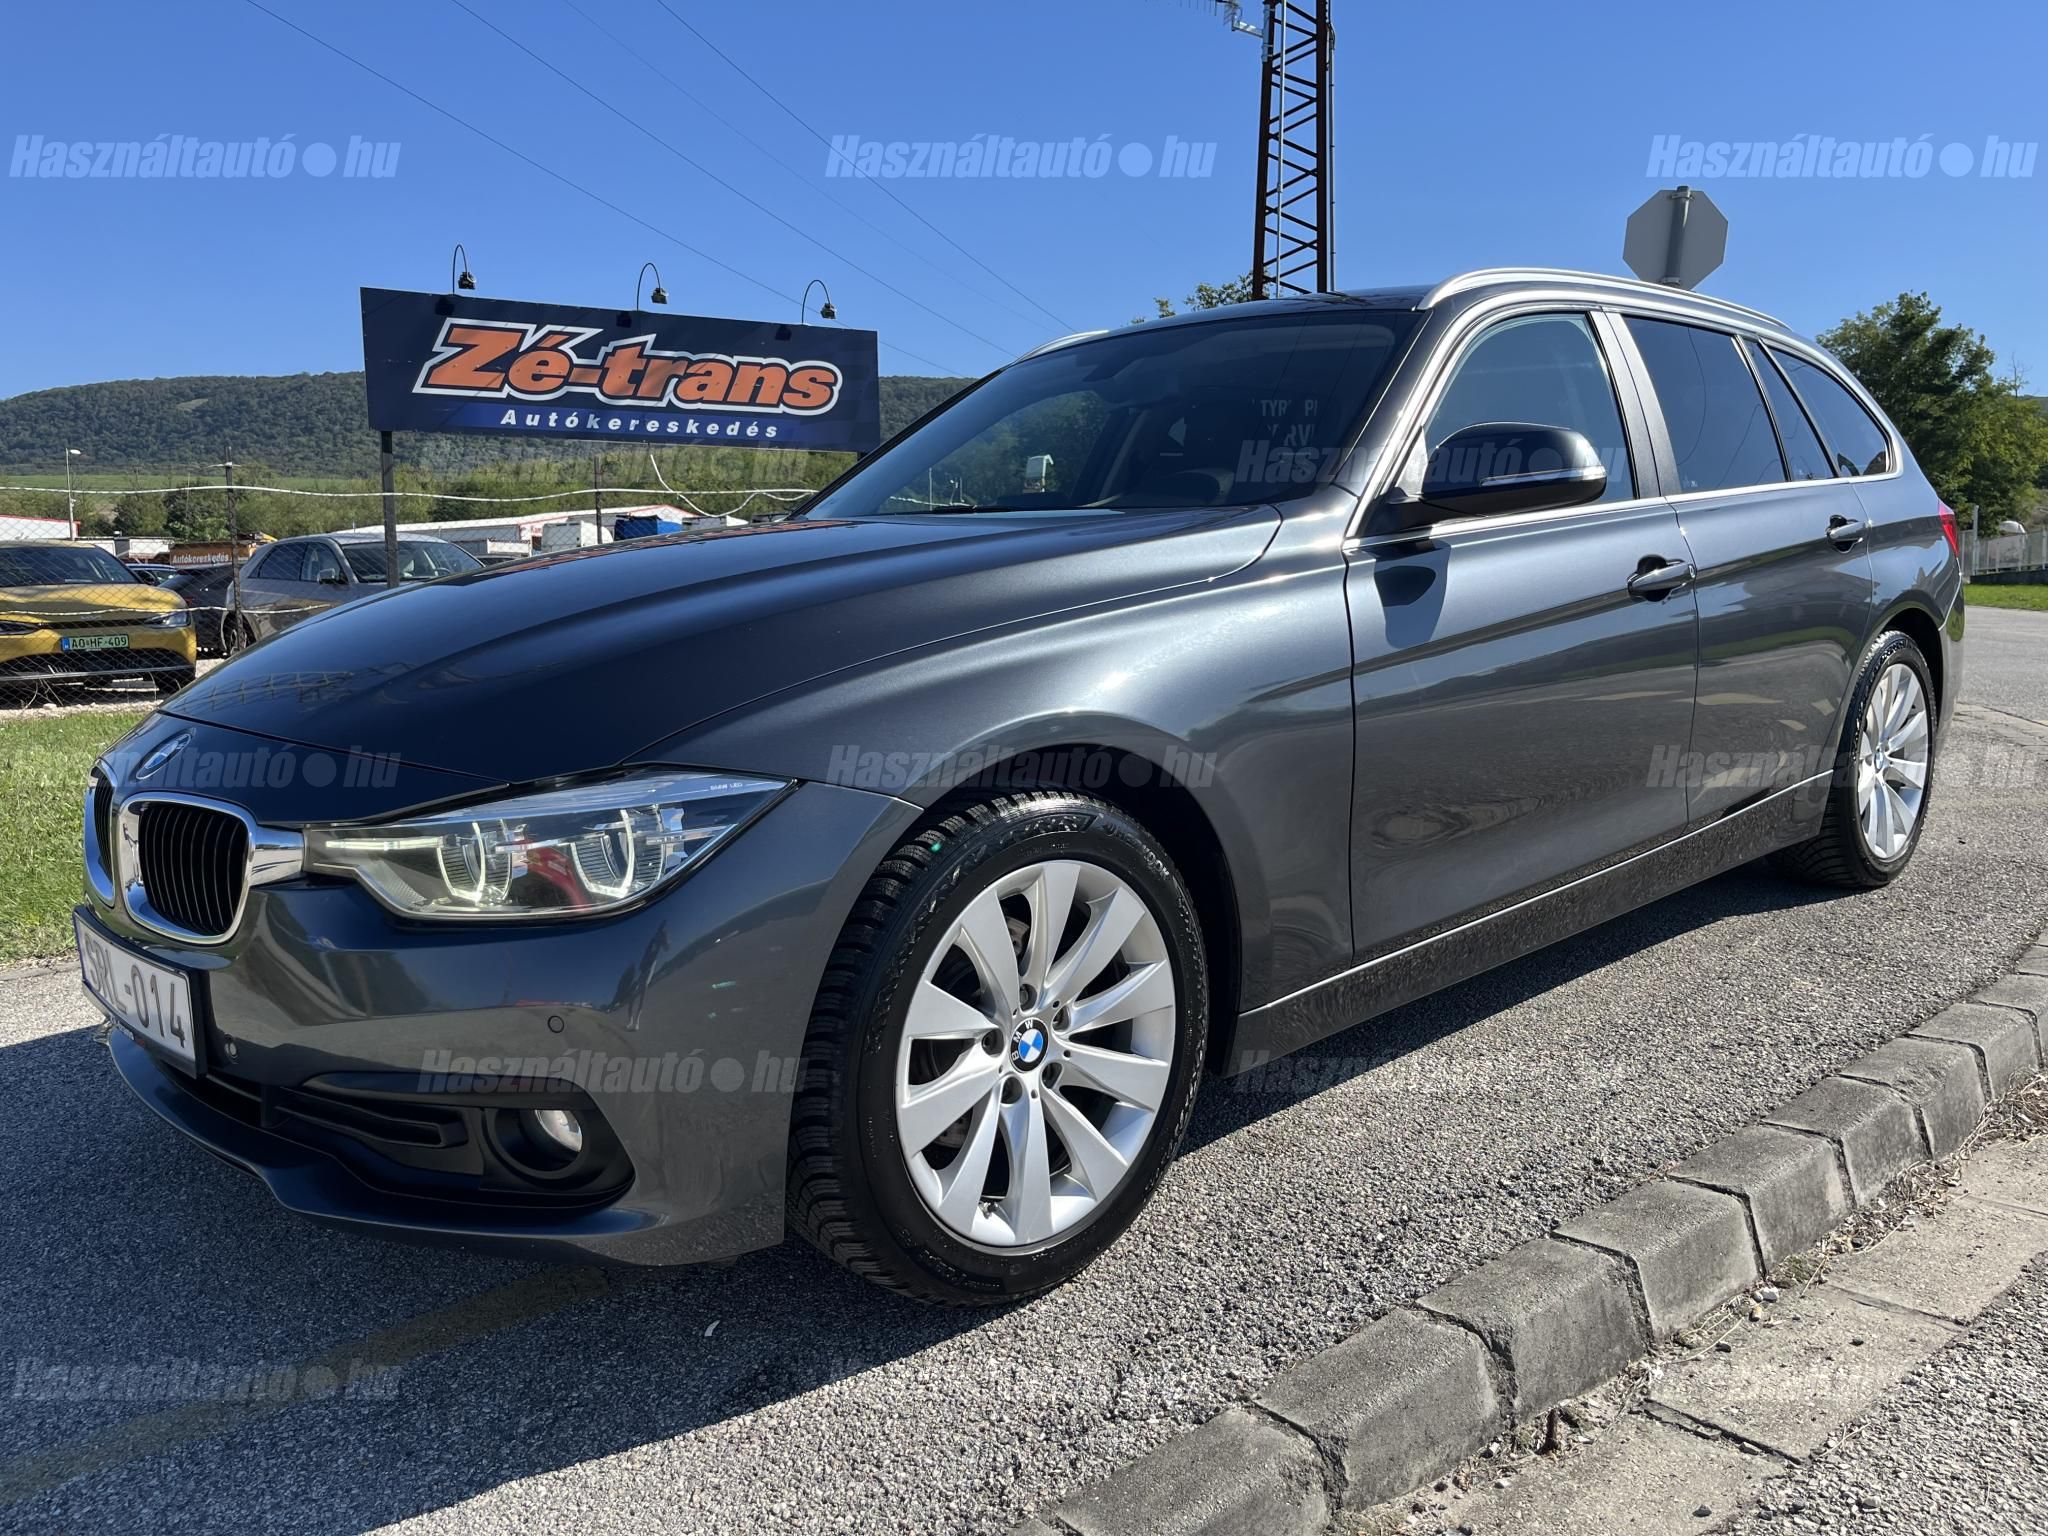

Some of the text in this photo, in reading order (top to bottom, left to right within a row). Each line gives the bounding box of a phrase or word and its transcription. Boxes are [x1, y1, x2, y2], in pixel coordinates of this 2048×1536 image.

[414, 318, 841, 415] Zé-trans
[501, 409, 778, 438] Autókereskedés
[1011, 1019, 1034, 1061] BMW
